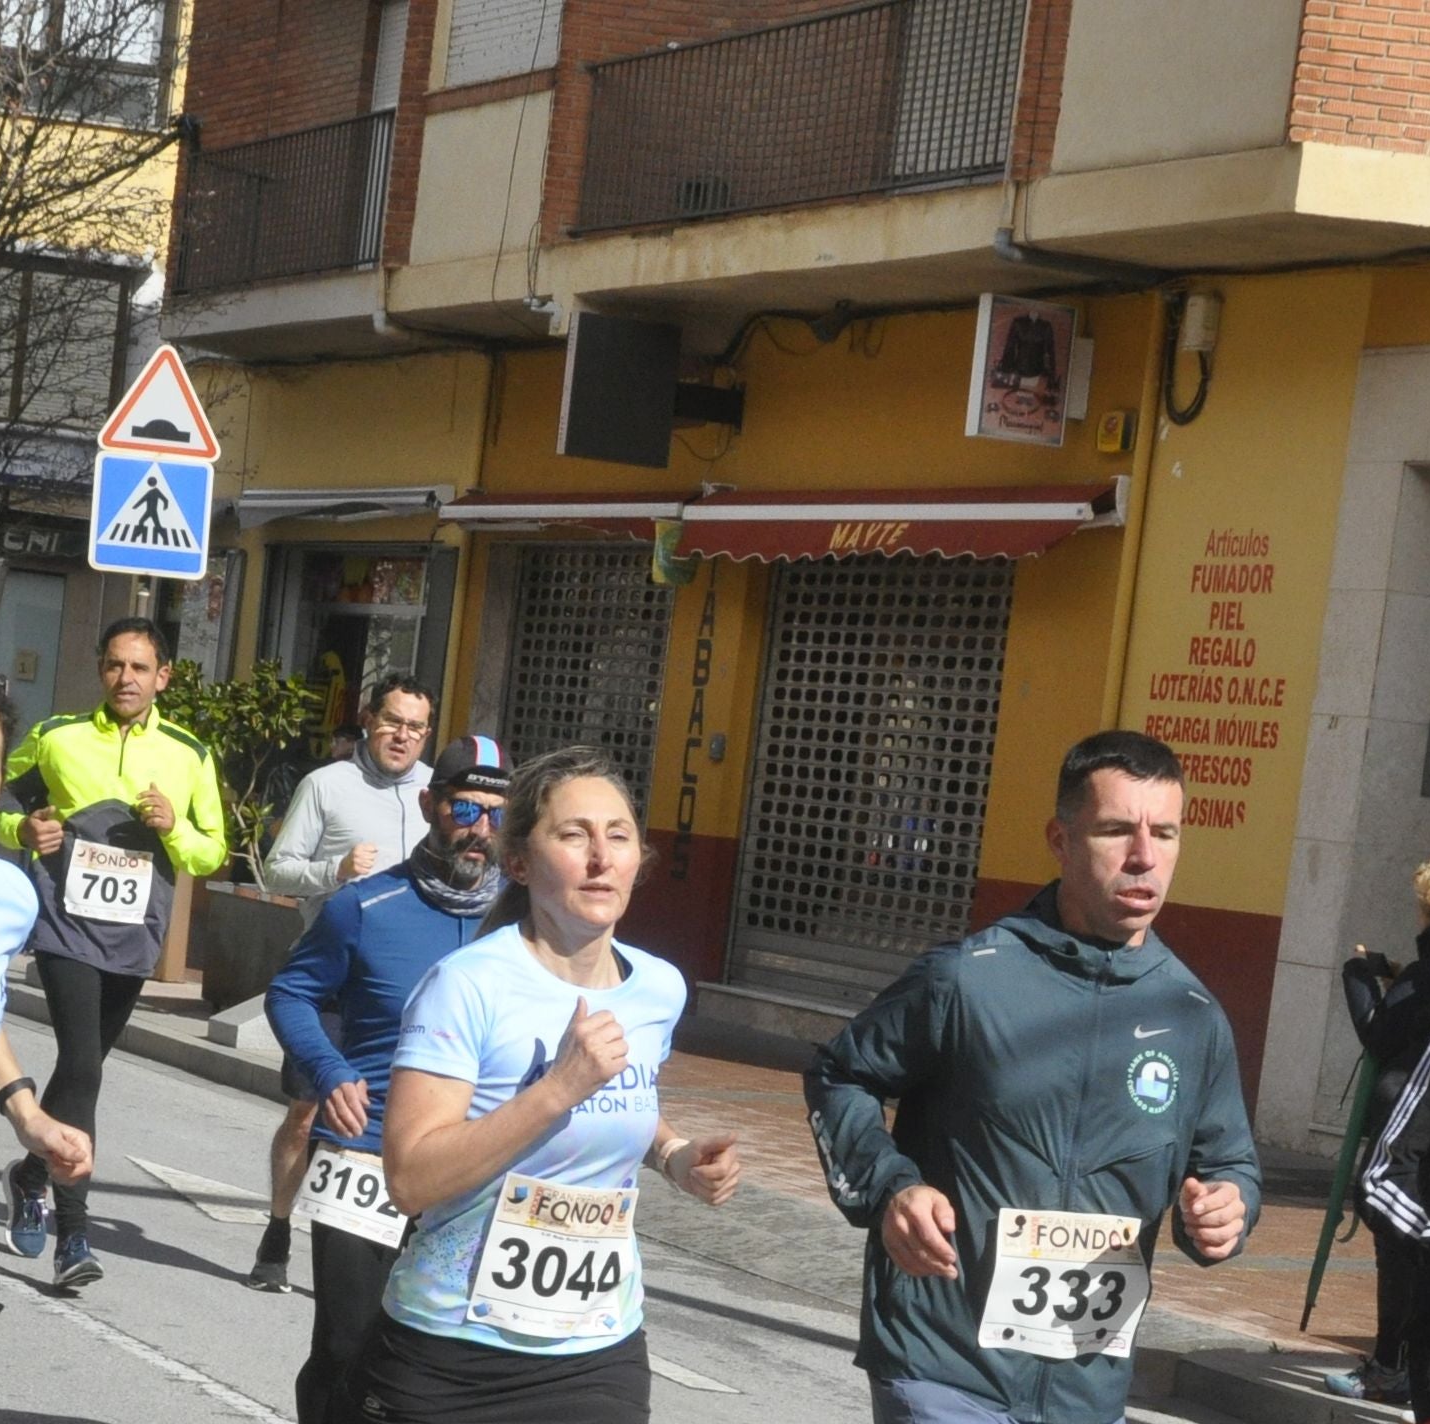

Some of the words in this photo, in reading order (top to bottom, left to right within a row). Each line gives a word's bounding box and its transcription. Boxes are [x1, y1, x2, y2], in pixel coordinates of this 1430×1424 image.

[829, 523, 910, 549] MAYTE
[1204, 528, 1269, 557] Artículos
[1191, 564, 1274, 594] FUMADOR
[1209, 601, 1245, 631] PIEL
[1188, 636, 1256, 667] REGALO
[1149, 668, 1223, 703] LOTERÍAS
[1227, 677, 1286, 707] O.N.C.E
[1145, 715, 1210, 744] RECARGA
[1214, 714, 1279, 749] MÓVILES
[1175, 753, 1252, 786] FRESCOS
[90, 850, 139, 868] FONDO
[82, 873, 137, 905] 703
[535, 1195, 615, 1226] FONDO
[1036, 1224, 1122, 1252] FONDO
[491, 1236, 622, 1301] 3044
[1012, 1265, 1127, 1322] 333
